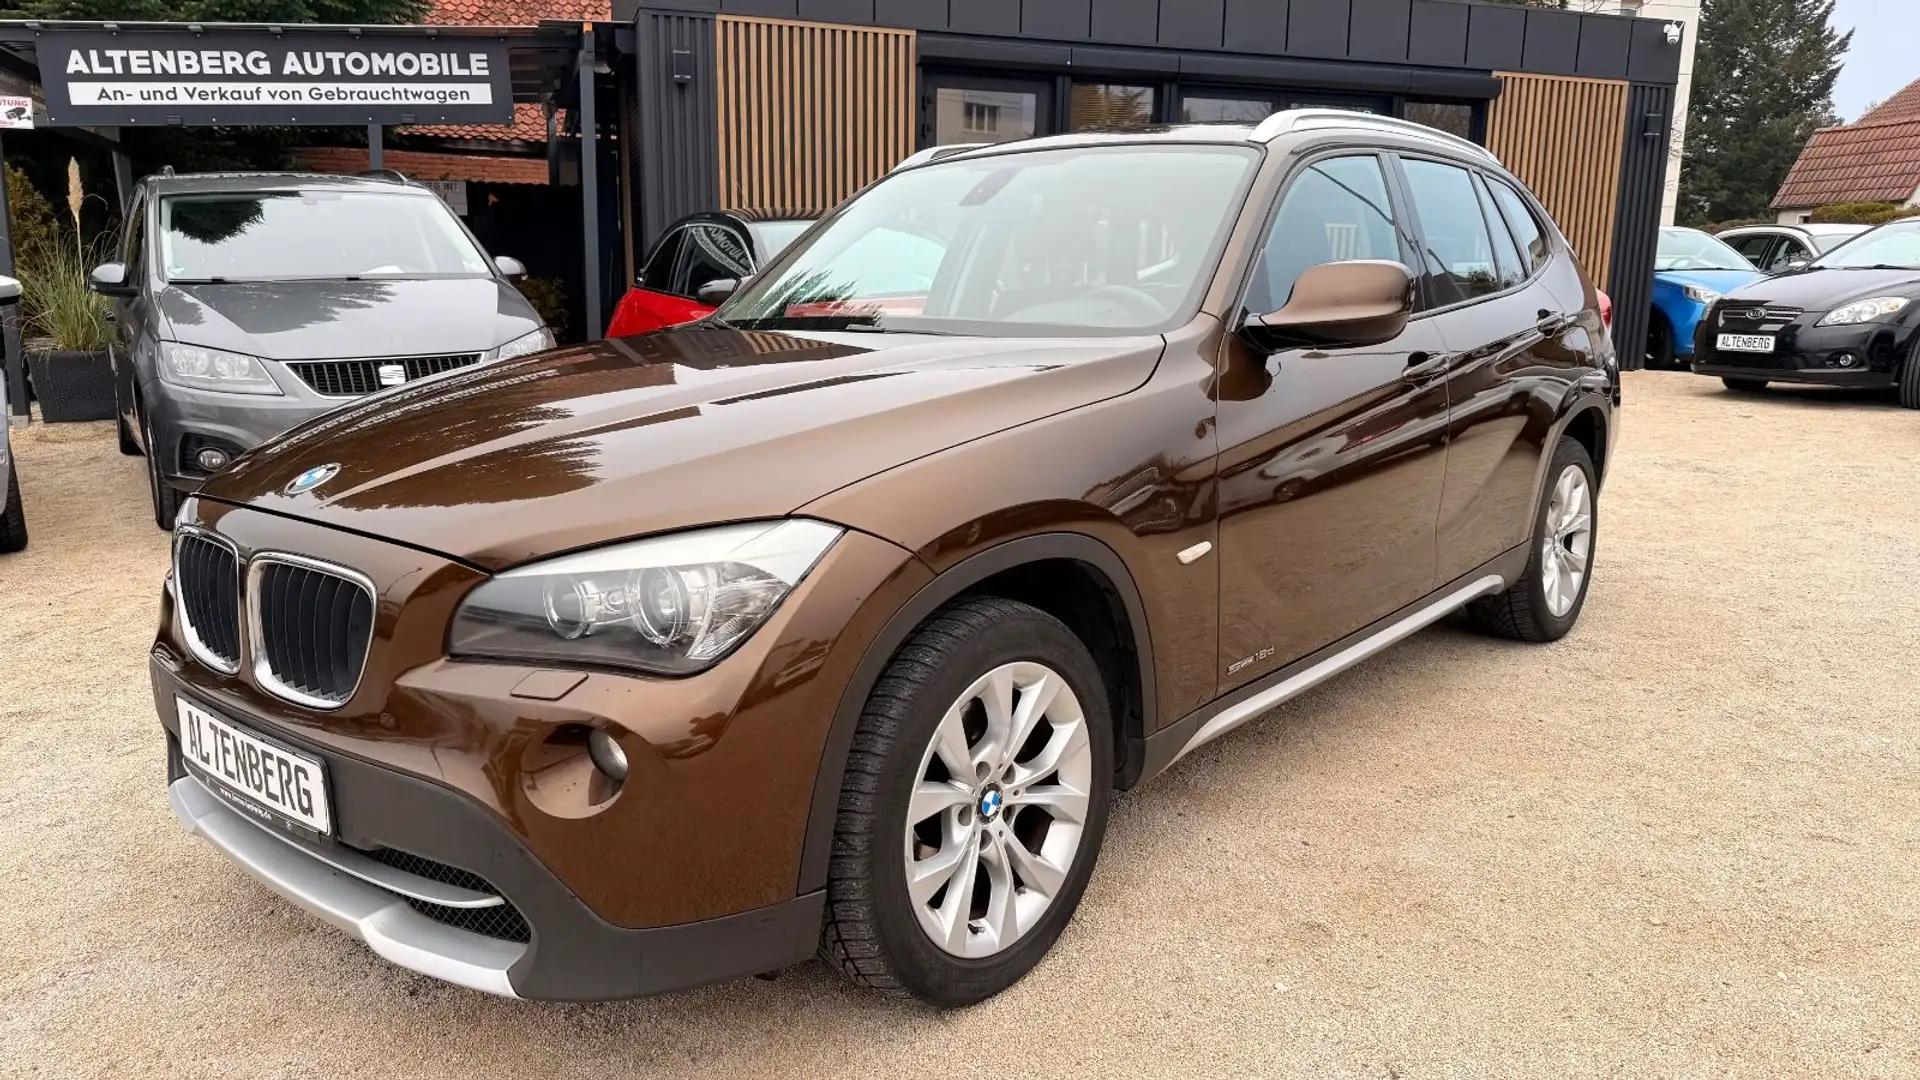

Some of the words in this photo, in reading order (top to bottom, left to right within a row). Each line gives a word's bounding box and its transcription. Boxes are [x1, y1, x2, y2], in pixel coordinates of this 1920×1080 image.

[66, 49, 271, 76] ALTENBERG
[283, 51, 489, 76] AUTOMOBILE
[0, 98, 29, 107] TUNG
[97, 86, 133, 101] An-
[139, 86, 177, 101] und
[183, 86, 262, 102] Verkauf
[268, 89, 302, 102] von
[308, 86, 470, 103] Gebrauchtwagen
[1721, 336, 1771, 349] ALTENBERG
[187, 710, 315, 818] ALTENBERG
